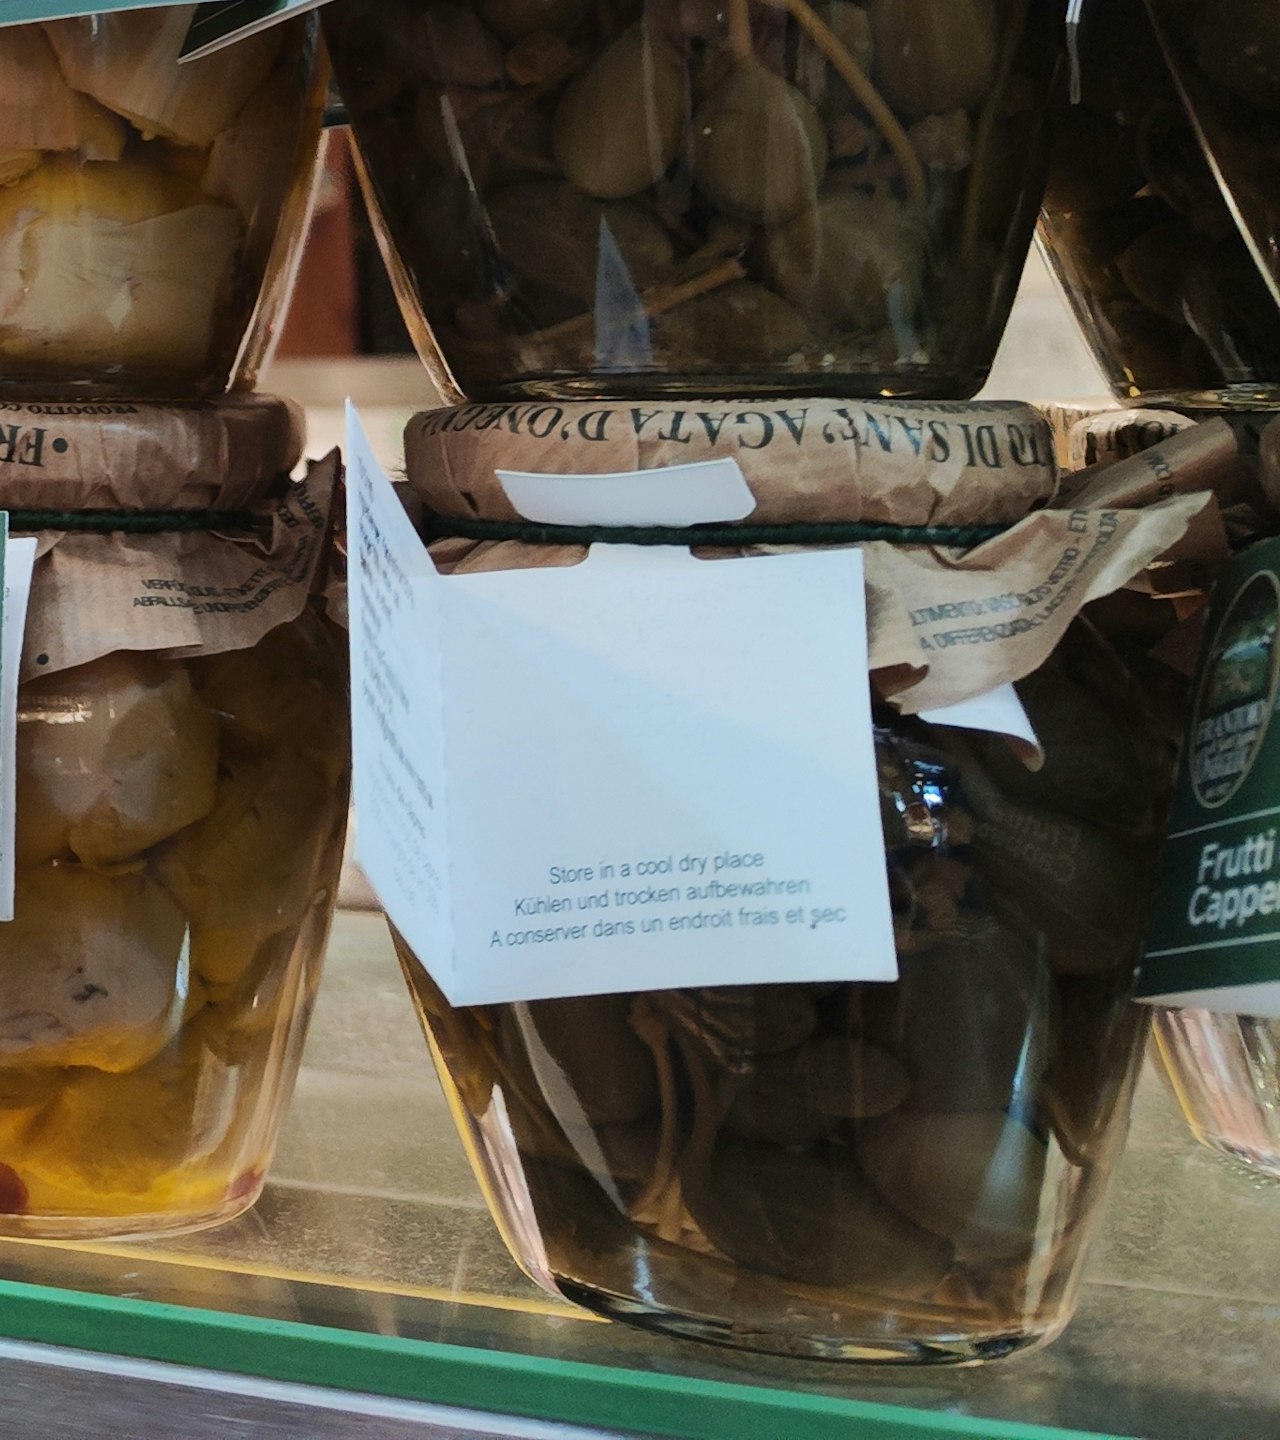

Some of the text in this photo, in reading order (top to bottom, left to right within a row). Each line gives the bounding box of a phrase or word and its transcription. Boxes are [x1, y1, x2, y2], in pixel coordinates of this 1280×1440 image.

[549, 851, 766, 885] Store in a cool dry place
[1197, 828, 1277, 884] Frutti
[514, 877, 811, 917] Kühlen und trocken aufbewahren
[490, 931, 503, 948] A
[506, 923, 588, 947] conserver
[593, 918, 635, 938] dans
[641, 916, 663, 933] un
[669, 908, 733, 930] endroit
[737, 907, 779, 926] frais
[786, 907, 804, 925] et
